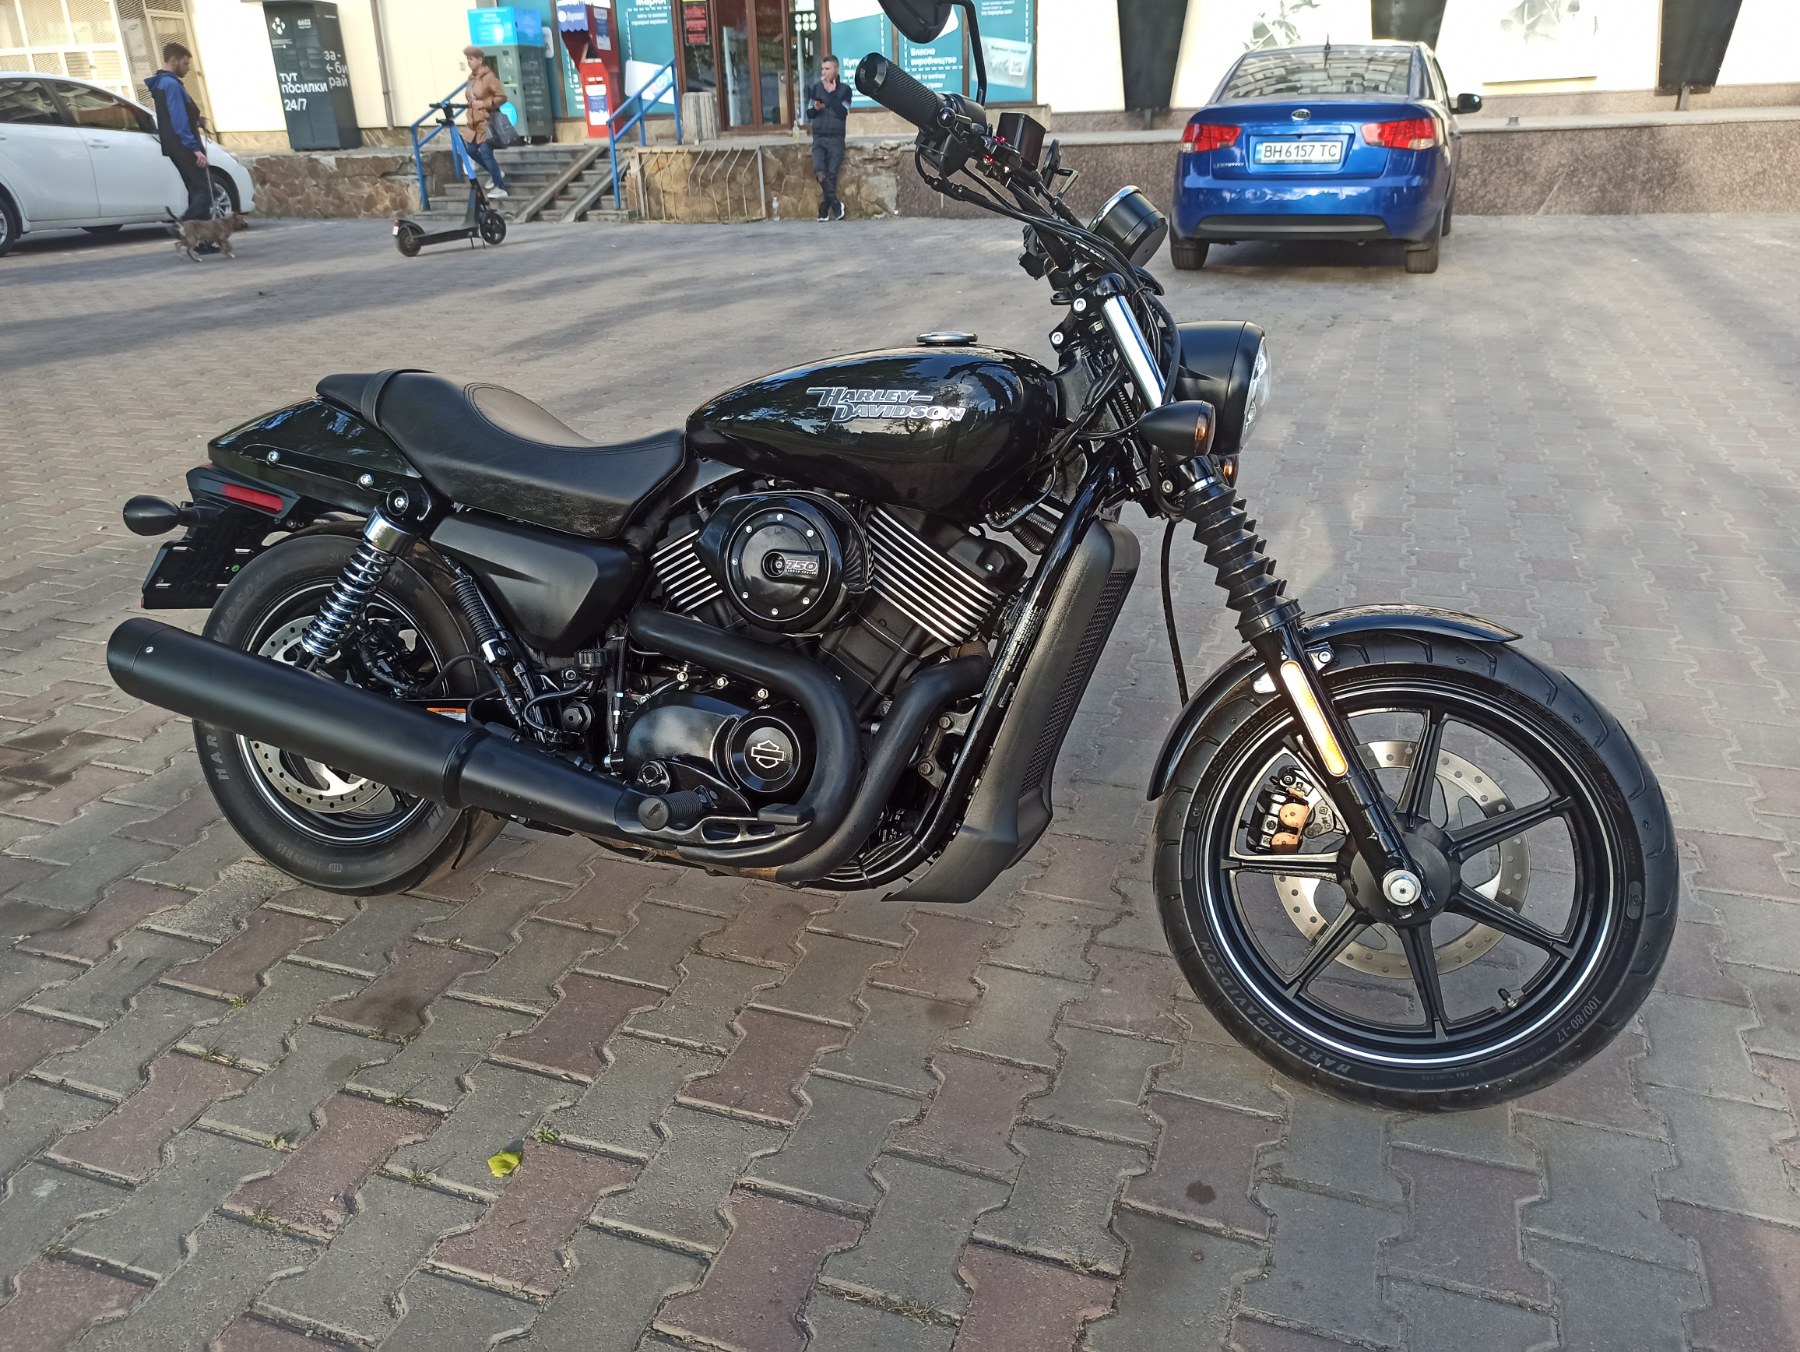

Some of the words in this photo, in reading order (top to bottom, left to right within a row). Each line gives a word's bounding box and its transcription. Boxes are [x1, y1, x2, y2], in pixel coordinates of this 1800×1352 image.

[910, 48, 936, 57] Власне
[910, 56, 958, 67] виробництво
[279, 73, 297, 84] тут
[281, 83, 328, 93] посилки
[284, 98, 307, 111] 24/7
[1263, 145, 1283, 158] BH
[1284, 144, 1315, 158] 6157
[1320, 144, 1338, 158] TC
[831, 402, 966, 422] DAVIDSON
[786, 559, 819, 572] 750
[1200, 941, 1352, 1074] HARLEY-DAVIDSON
[1556, 995, 1602, 1043] 100/80-17
